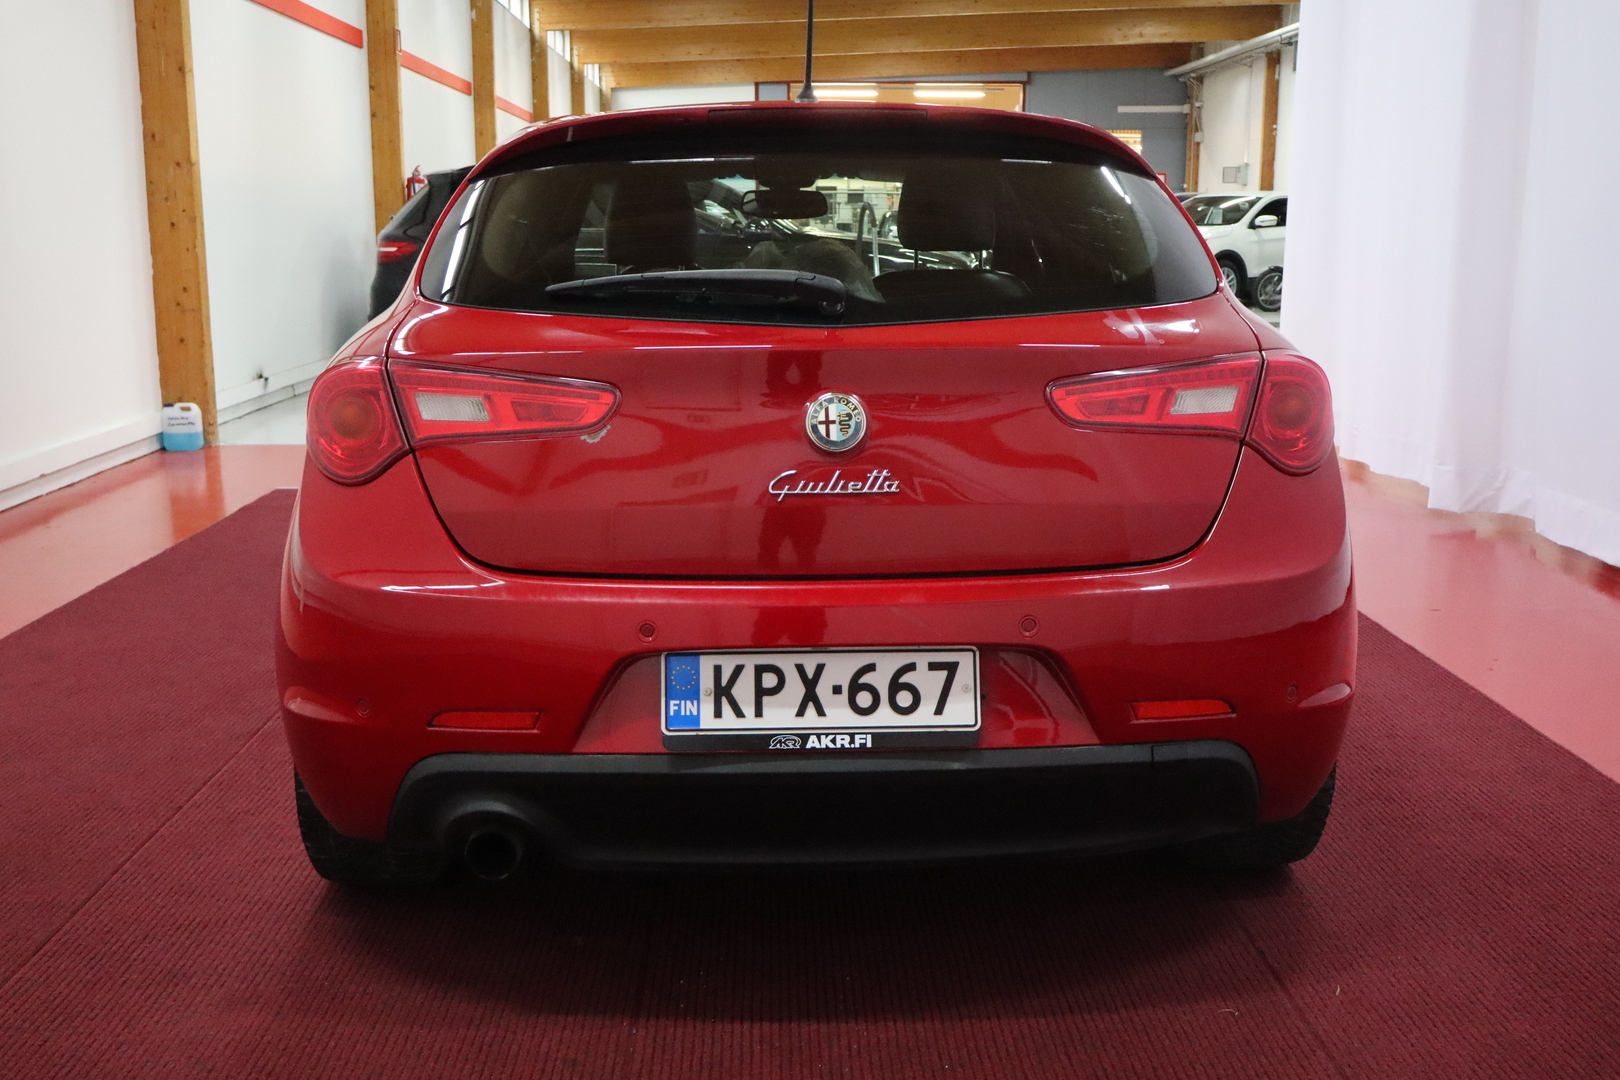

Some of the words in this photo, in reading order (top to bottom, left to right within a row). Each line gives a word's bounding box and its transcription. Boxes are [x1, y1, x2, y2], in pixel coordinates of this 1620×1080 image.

[810, 400, 829, 425] ALFA
[834, 396, 861, 422] ROMEO
[768, 469, 900, 502] Giulietta
[713, 661, 960, 719] KPX-667
[669, 700, 698, 716] FIN
[805, 734, 872, 749] AKR.FI
